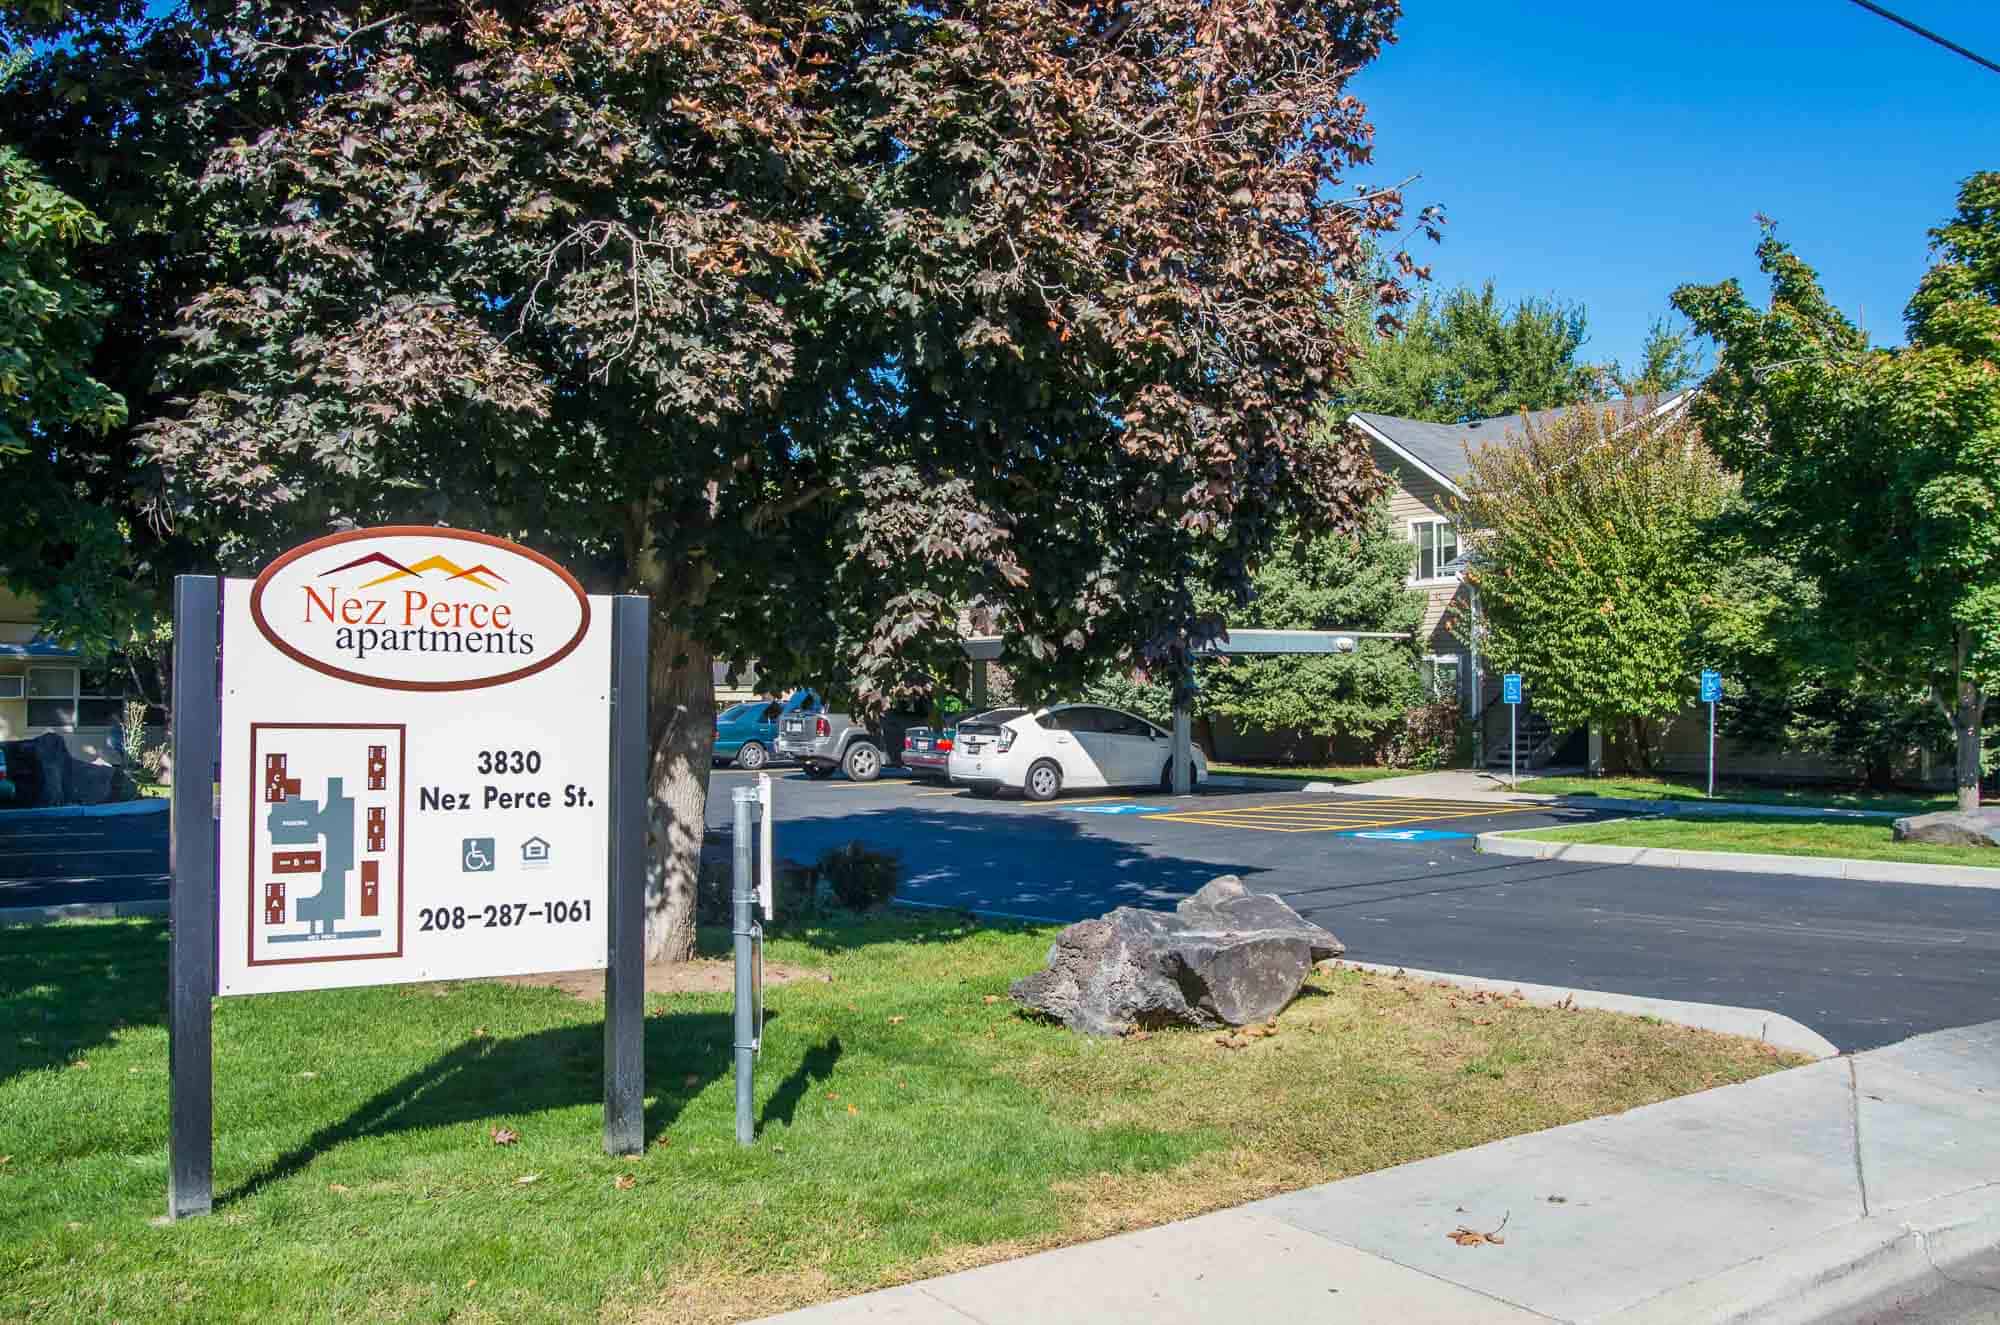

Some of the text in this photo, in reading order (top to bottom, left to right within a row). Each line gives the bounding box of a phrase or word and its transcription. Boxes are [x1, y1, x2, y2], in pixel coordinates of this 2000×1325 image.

[302, 585, 512, 629] Nez Perce
[335, 625, 534, 659] apartments
[477, 750, 542, 775] 3830
[419, 783, 595, 811] Nez Perce St.
[418, 899, 592, 932] 208-287-1061
